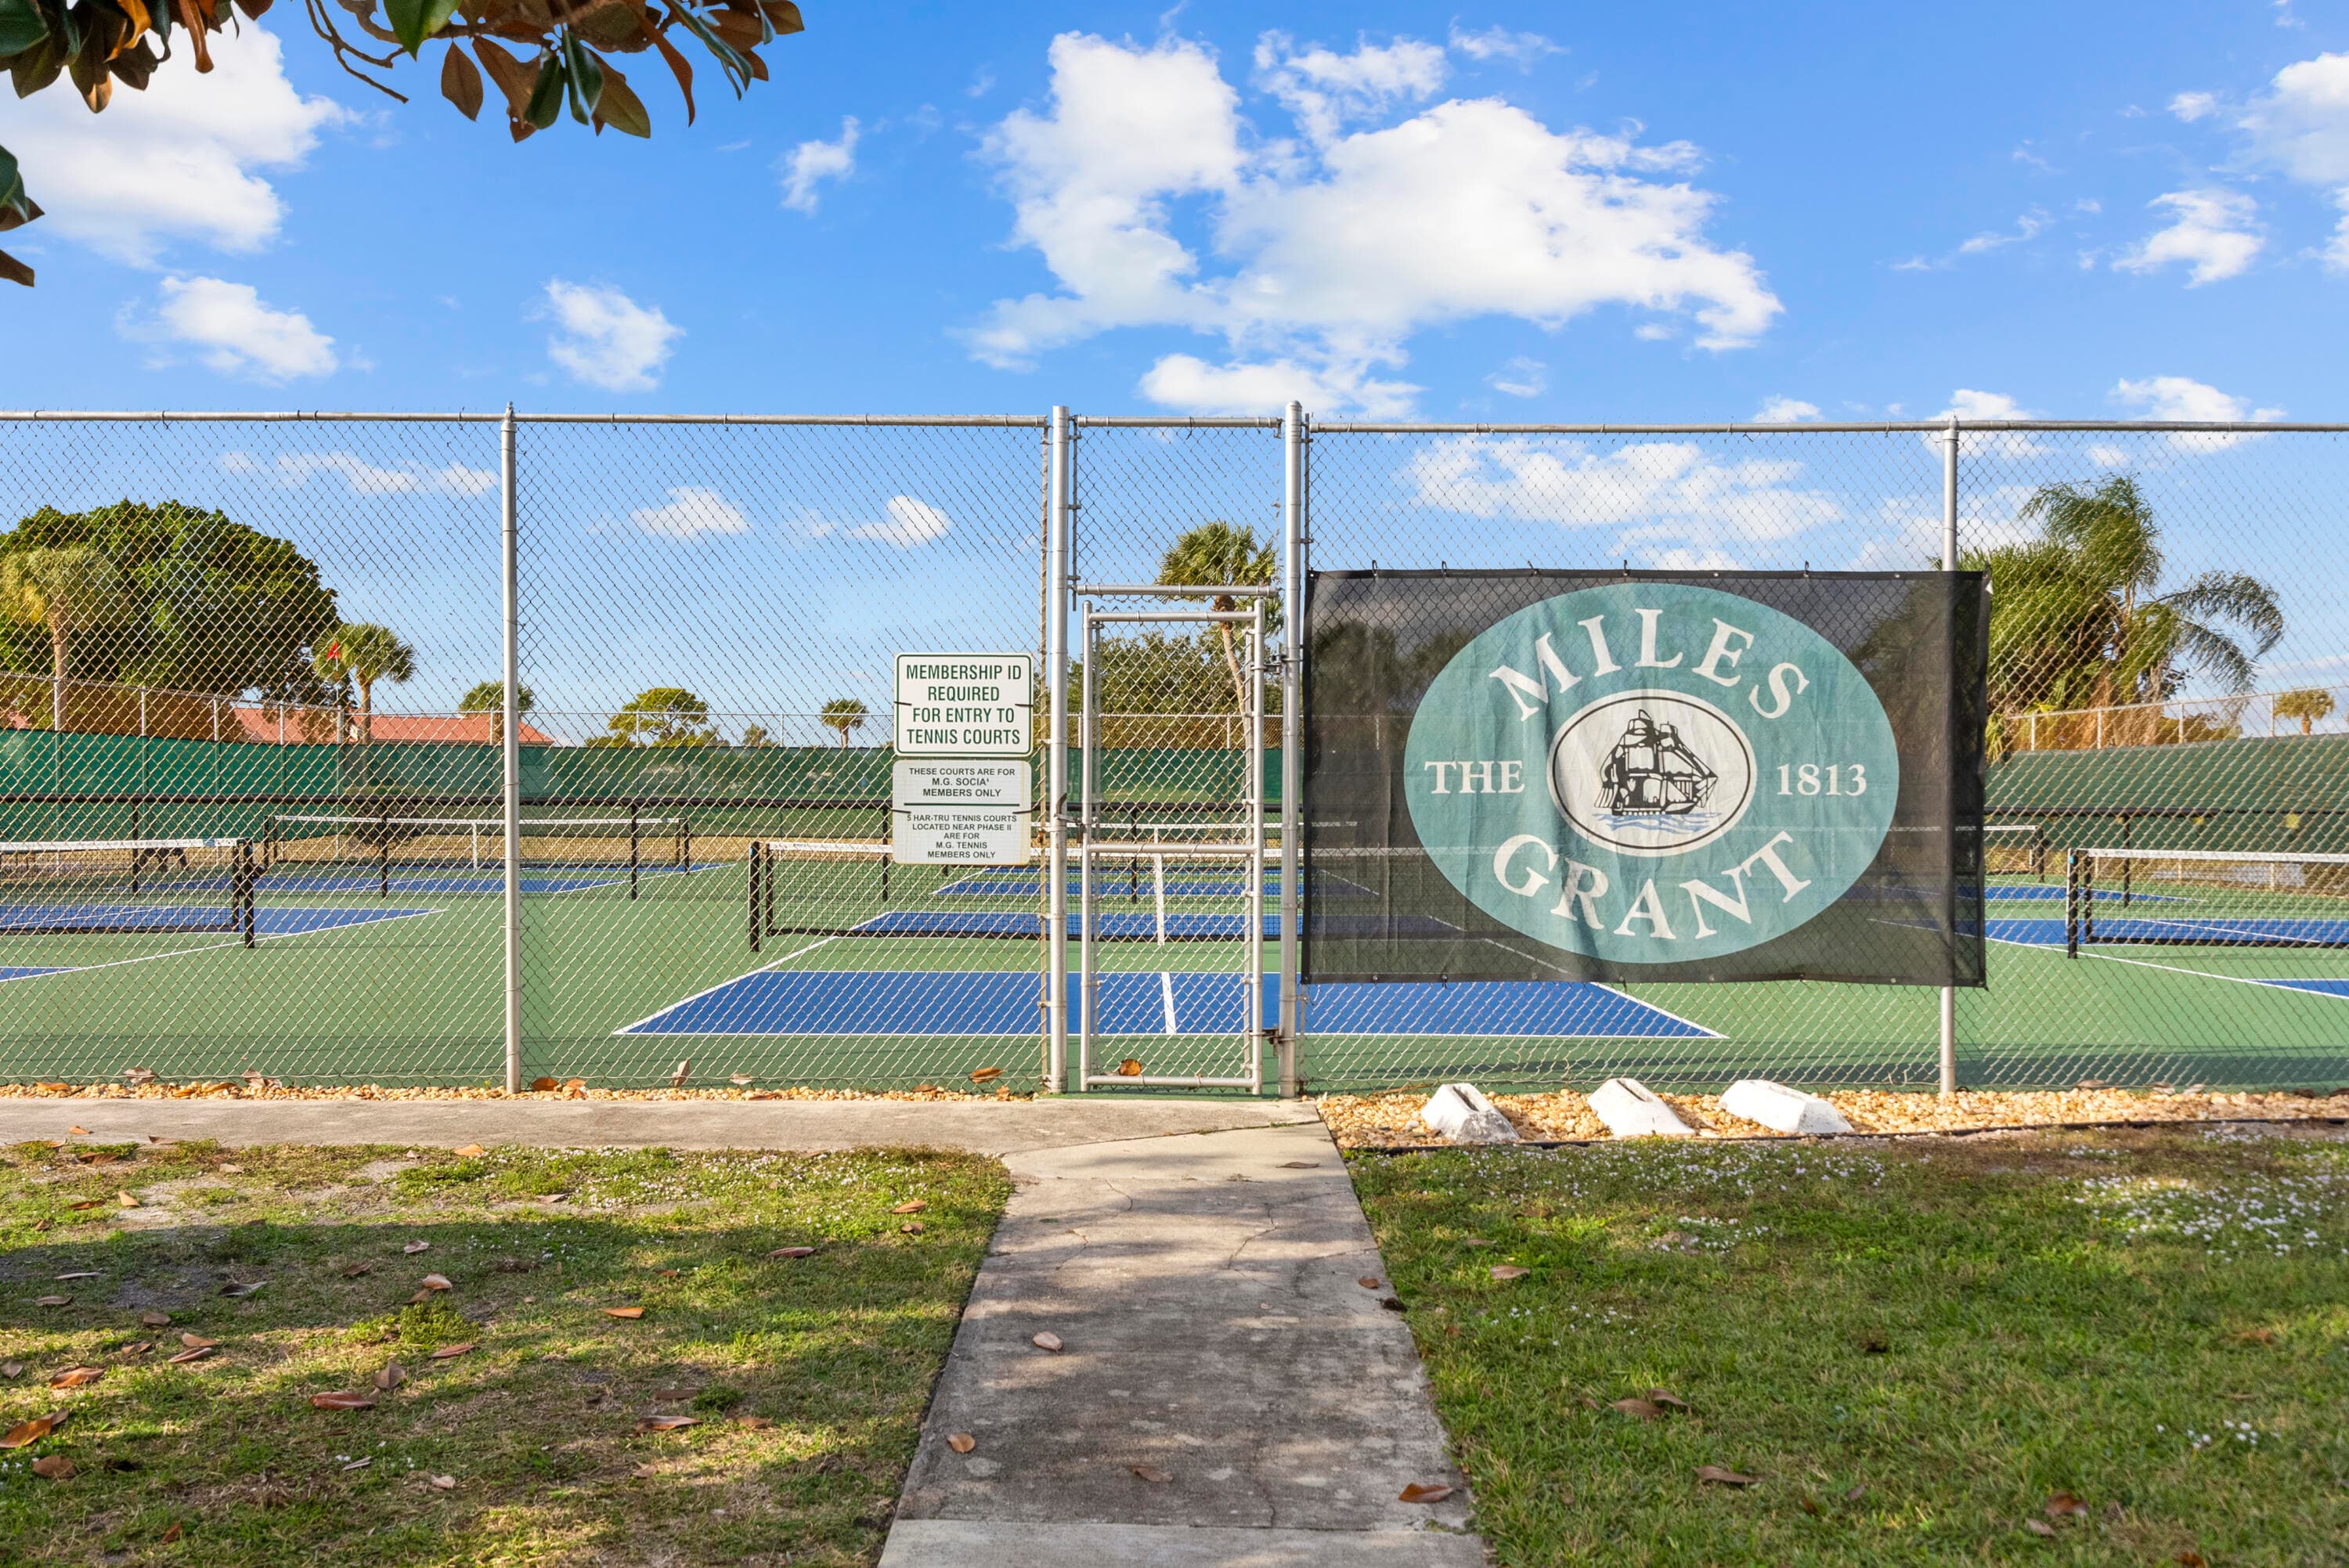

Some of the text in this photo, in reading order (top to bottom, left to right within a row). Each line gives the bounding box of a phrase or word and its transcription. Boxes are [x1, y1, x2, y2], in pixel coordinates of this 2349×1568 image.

[907, 665, 1022, 679] MEMBERSHIP ID
[1489, 607, 1810, 722] MILES
[928, 686, 1000, 701] REQUIRED
[913, 708, 1015, 723] FOR ENTRY TO
[907, 729, 1020, 744] TENNIS COURTS
[940, 767, 975, 776] COURTS
[1423, 760, 1525, 795] THE
[1777, 762, 1867, 796] 1813
[932, 777, 953, 786] M.G.
[922, 788, 1002, 798] MEMBERS ONLY
[983, 814, 1018, 823] COURTS
[1493, 830, 1812, 940] GRANT
